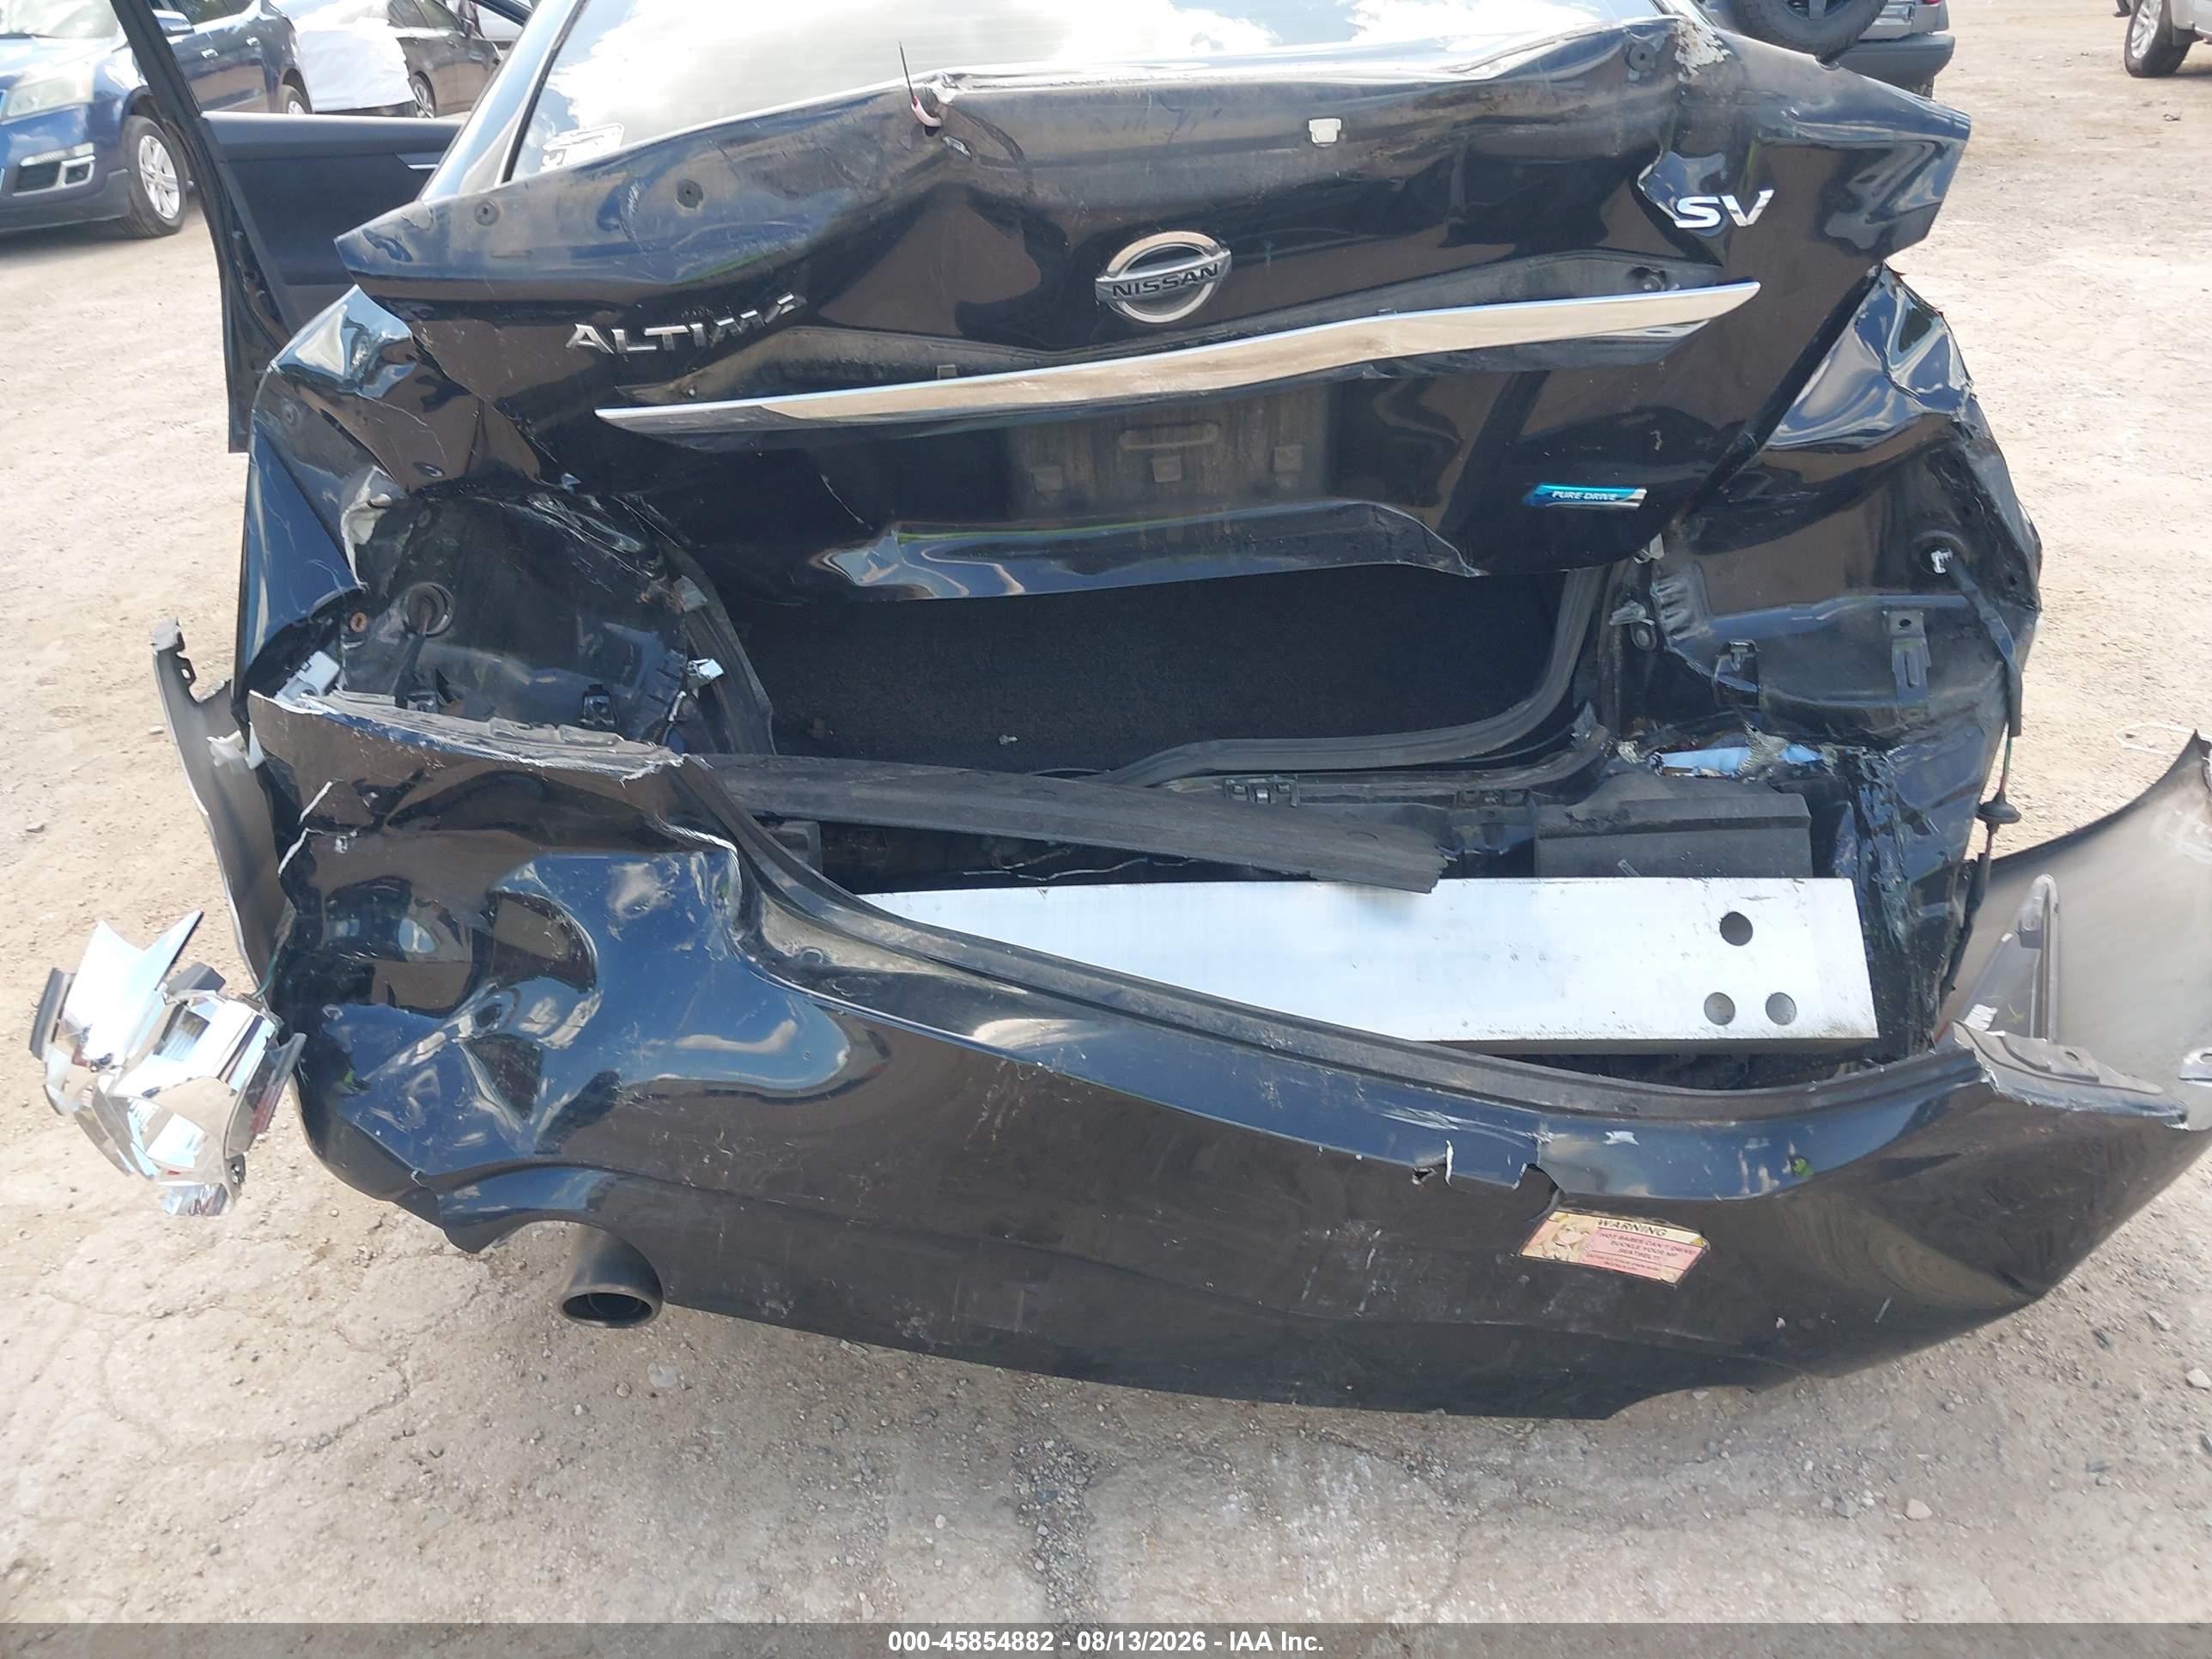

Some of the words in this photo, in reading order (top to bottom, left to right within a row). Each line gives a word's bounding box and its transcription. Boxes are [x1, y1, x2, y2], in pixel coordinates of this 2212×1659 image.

[1675, 189, 1775, 228] SV
[1112, 263, 1219, 297] NISSAN
[1552, 490, 1582, 500] PURE
[1583, 492, 1618, 501] DRIVE
[1597, 1218, 1668, 1237] WARNING
